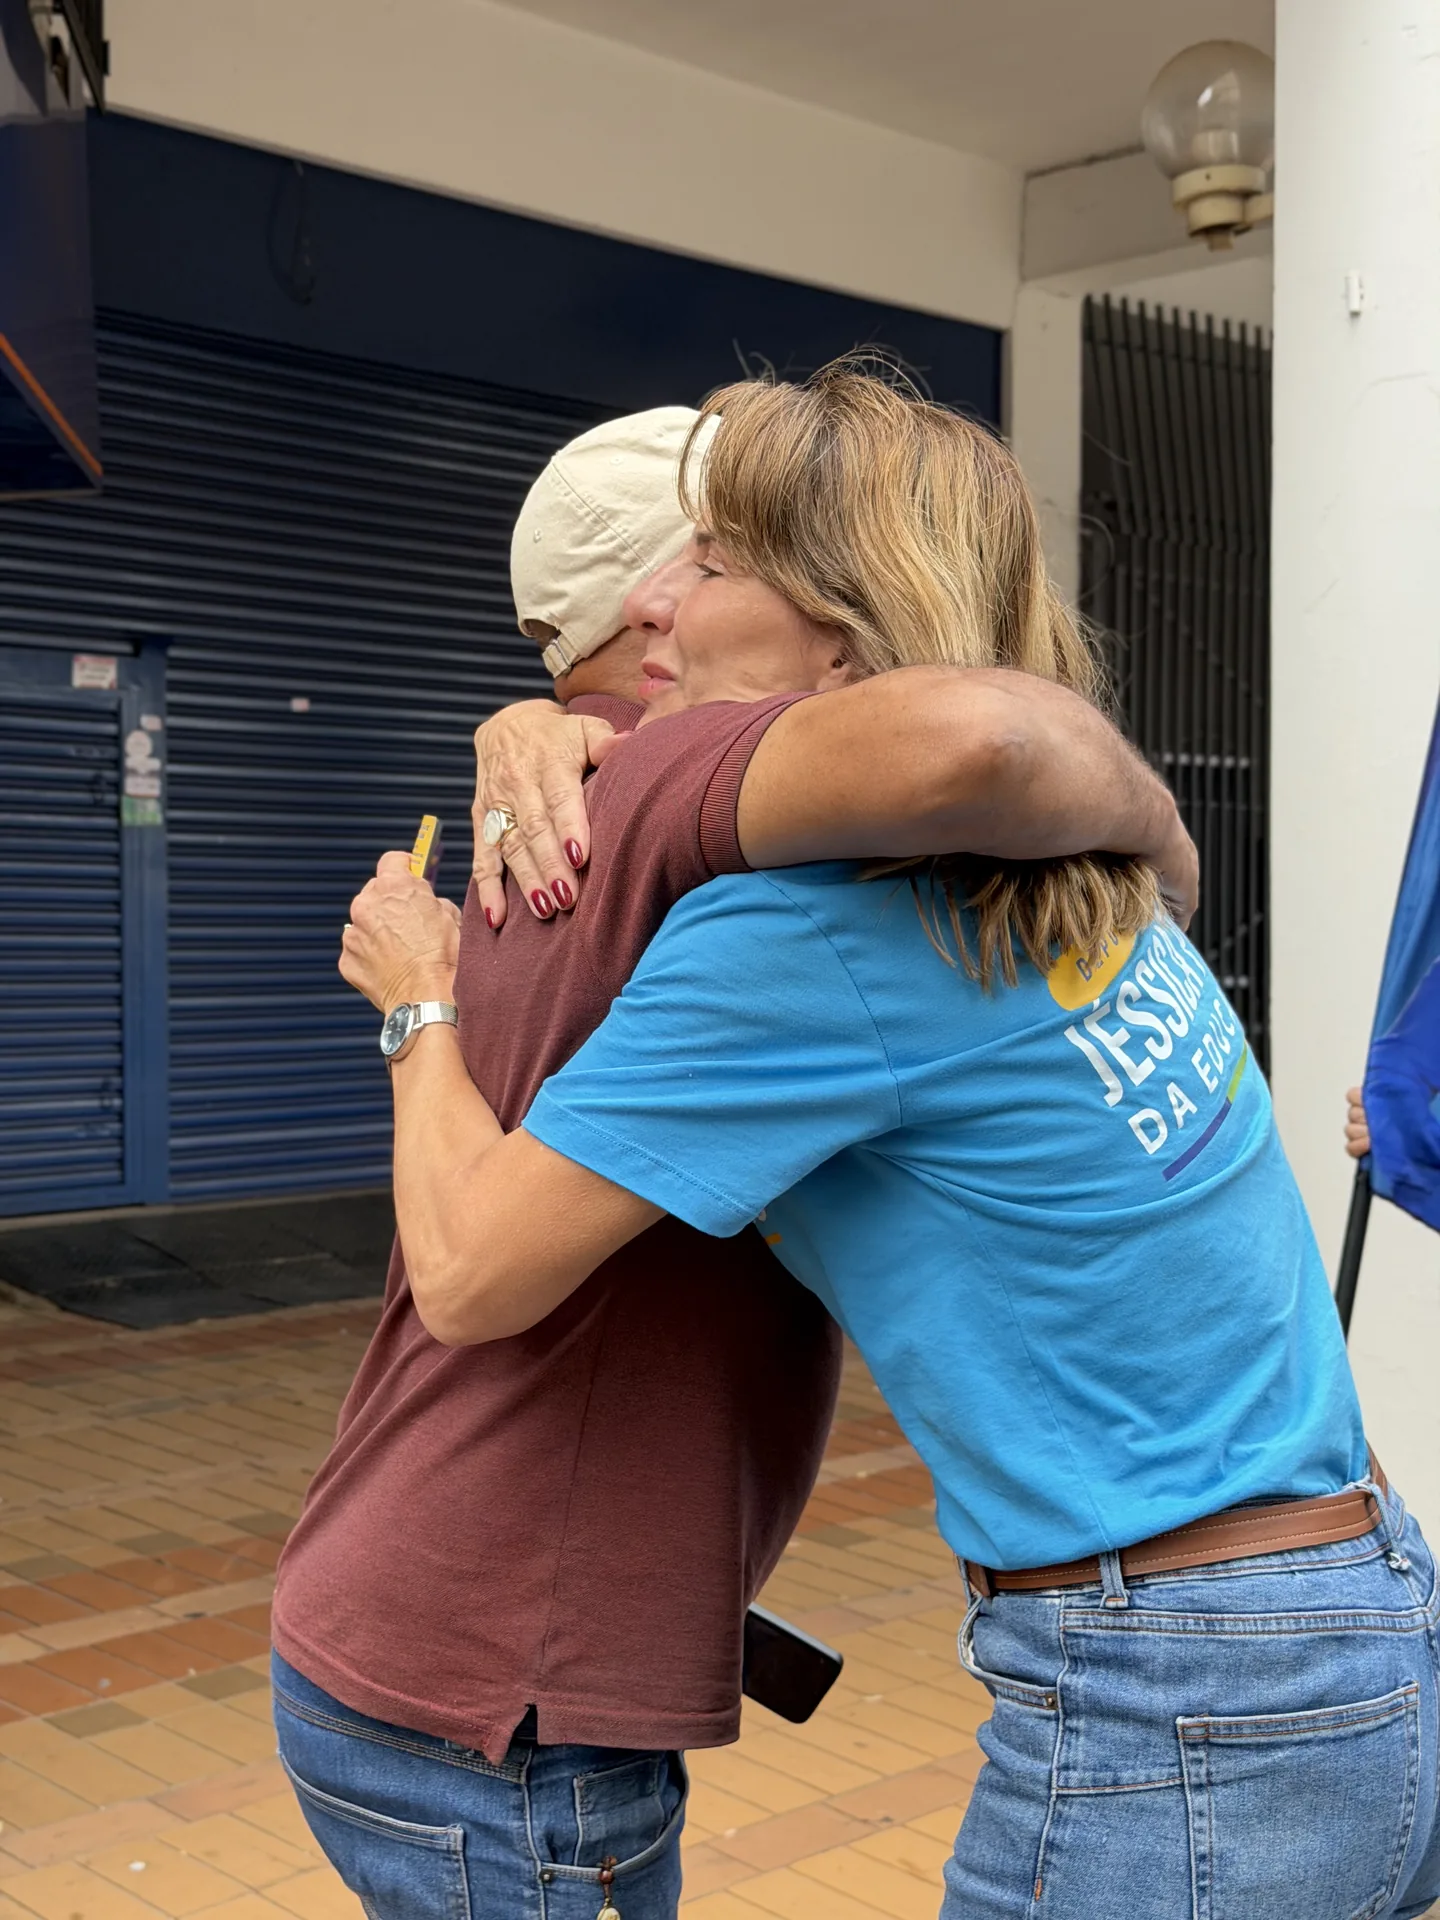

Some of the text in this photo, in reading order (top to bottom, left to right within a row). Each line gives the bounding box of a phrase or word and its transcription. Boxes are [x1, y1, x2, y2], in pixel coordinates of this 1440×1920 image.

[1063, 924, 1204, 1108] JÉSSICA
[1075, 928, 1119, 983] DPU
[1127, 998, 1238, 1155] DA EDUC
